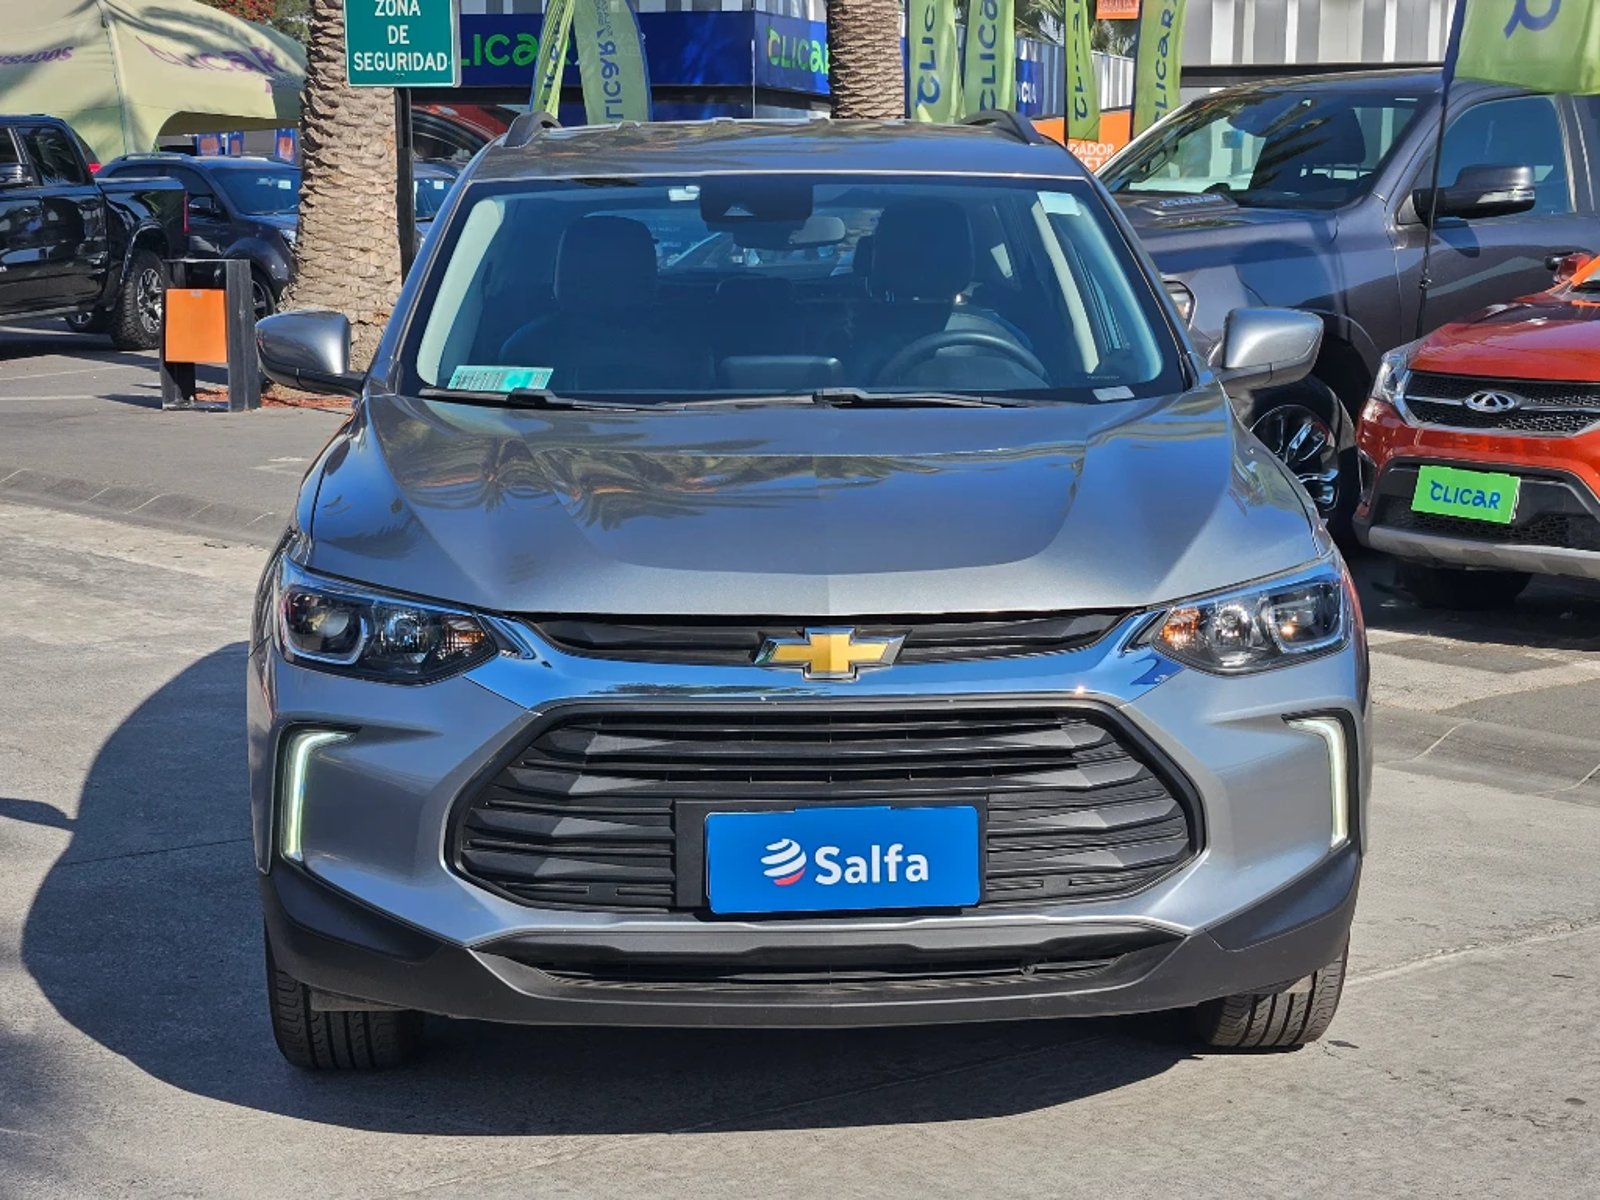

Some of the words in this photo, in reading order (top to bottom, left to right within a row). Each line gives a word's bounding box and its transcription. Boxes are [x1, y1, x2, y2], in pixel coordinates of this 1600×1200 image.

[374, 0, 421, 17] ZONA
[387, 25, 410, 44] DE
[353, 51, 448, 71] SEGURIDAD
[915, 0, 942, 105] CLIC
[814, 843, 929, 886] Salfa
